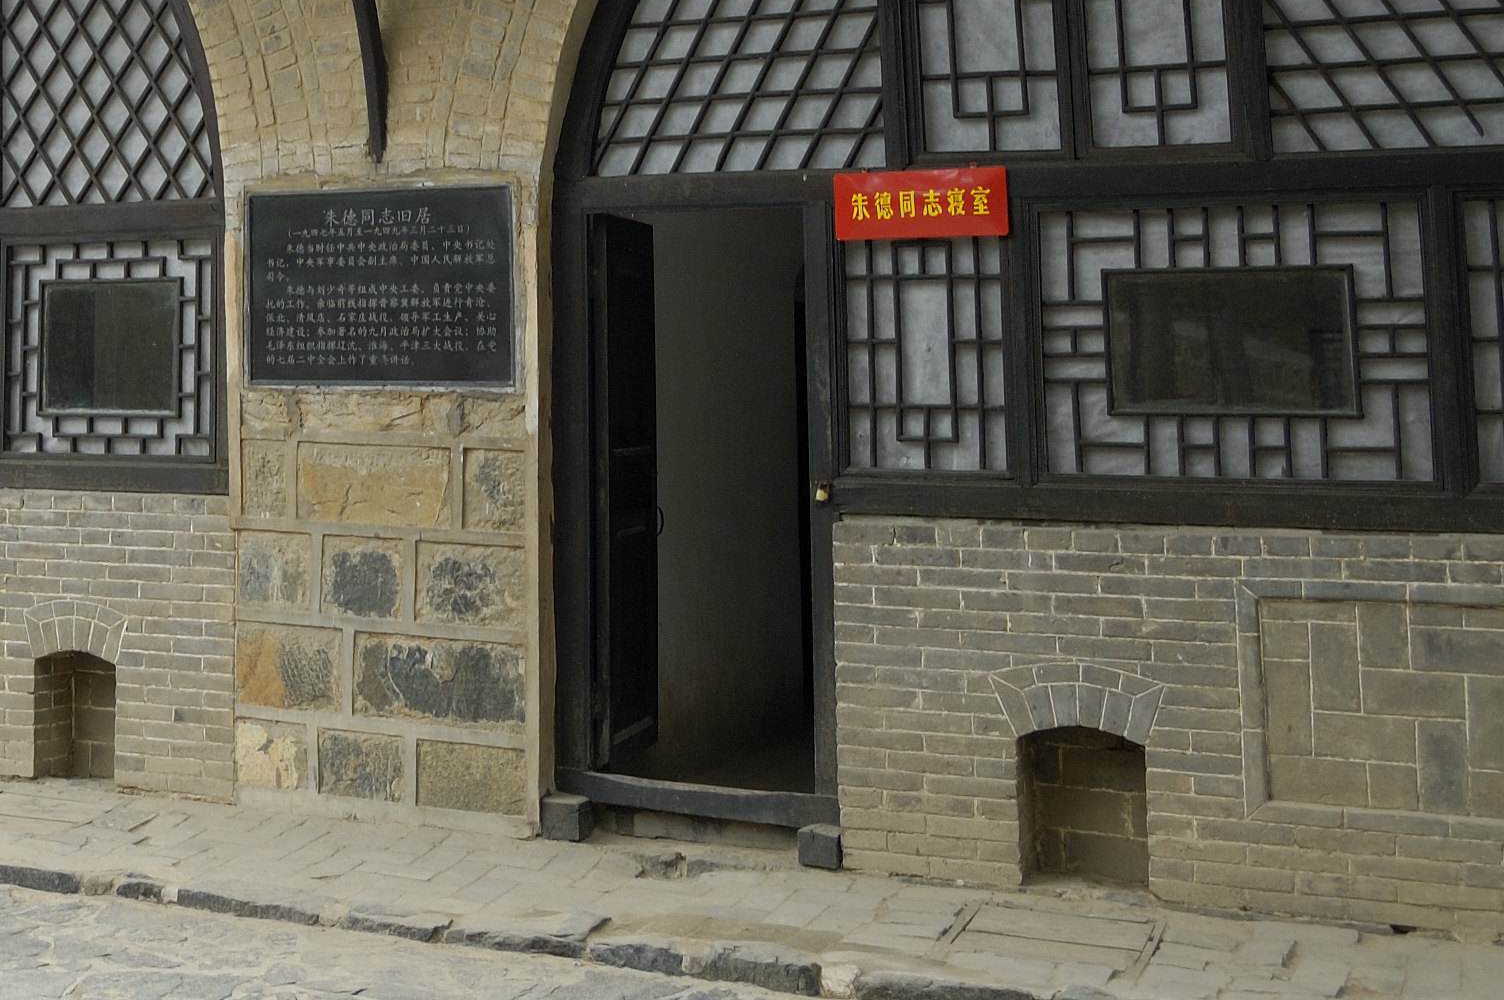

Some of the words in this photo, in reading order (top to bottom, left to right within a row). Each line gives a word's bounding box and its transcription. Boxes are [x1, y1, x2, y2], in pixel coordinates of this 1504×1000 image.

[323, 207, 432, 225] 朱德同志旧居
[850, 185, 992, 221] 朱德同志寝室
